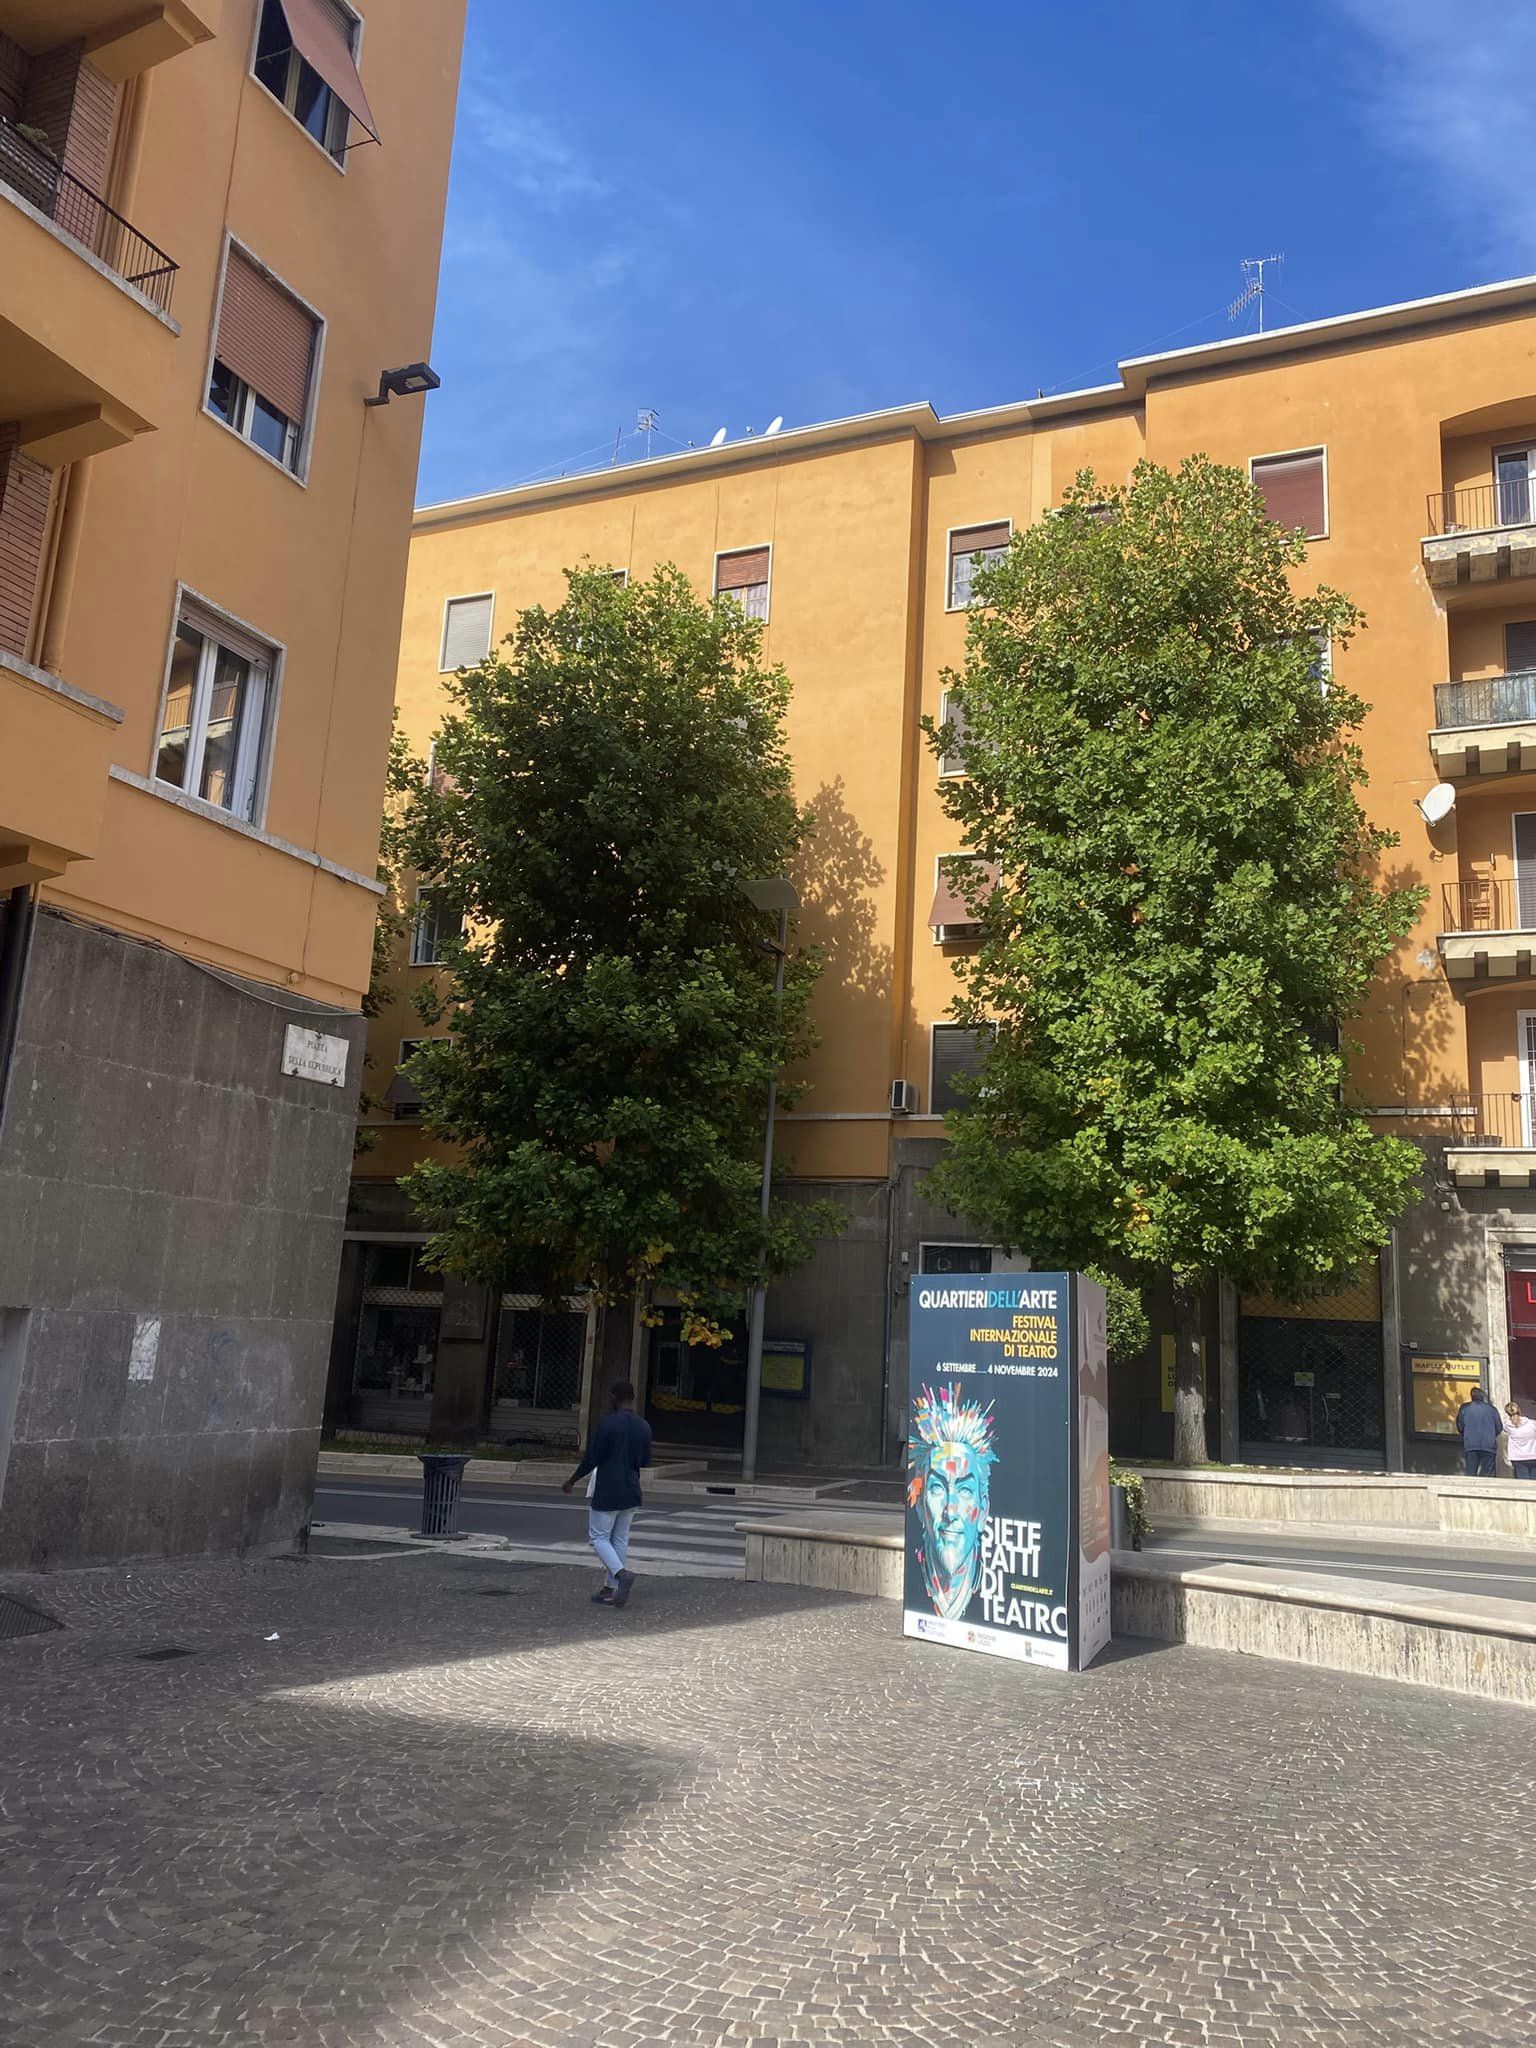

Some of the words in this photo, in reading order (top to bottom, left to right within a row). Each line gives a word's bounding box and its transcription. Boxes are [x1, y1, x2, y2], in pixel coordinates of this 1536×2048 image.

[1012, 1315, 1058, 1329] FESTIVAL
[970, 1328, 1058, 1344] INTERNAZIONALE
[1004, 1344, 1014, 1357] DI
[1017, 1345, 1058, 1359] TEATRO
[936, 1362, 941, 1372] 6
[942, 1362, 976, 1374] SETTEMBRE
[988, 1364, 993, 1375] 4
[994, 1364, 1035, 1377] NOVEMBRE
[1037, 1367, 1058, 1378] 2024
[981, 1516, 1041, 1554] SIETE
[981, 1541, 1041, 1579] FATTI
[981, 1567, 1005, 1600] DI
